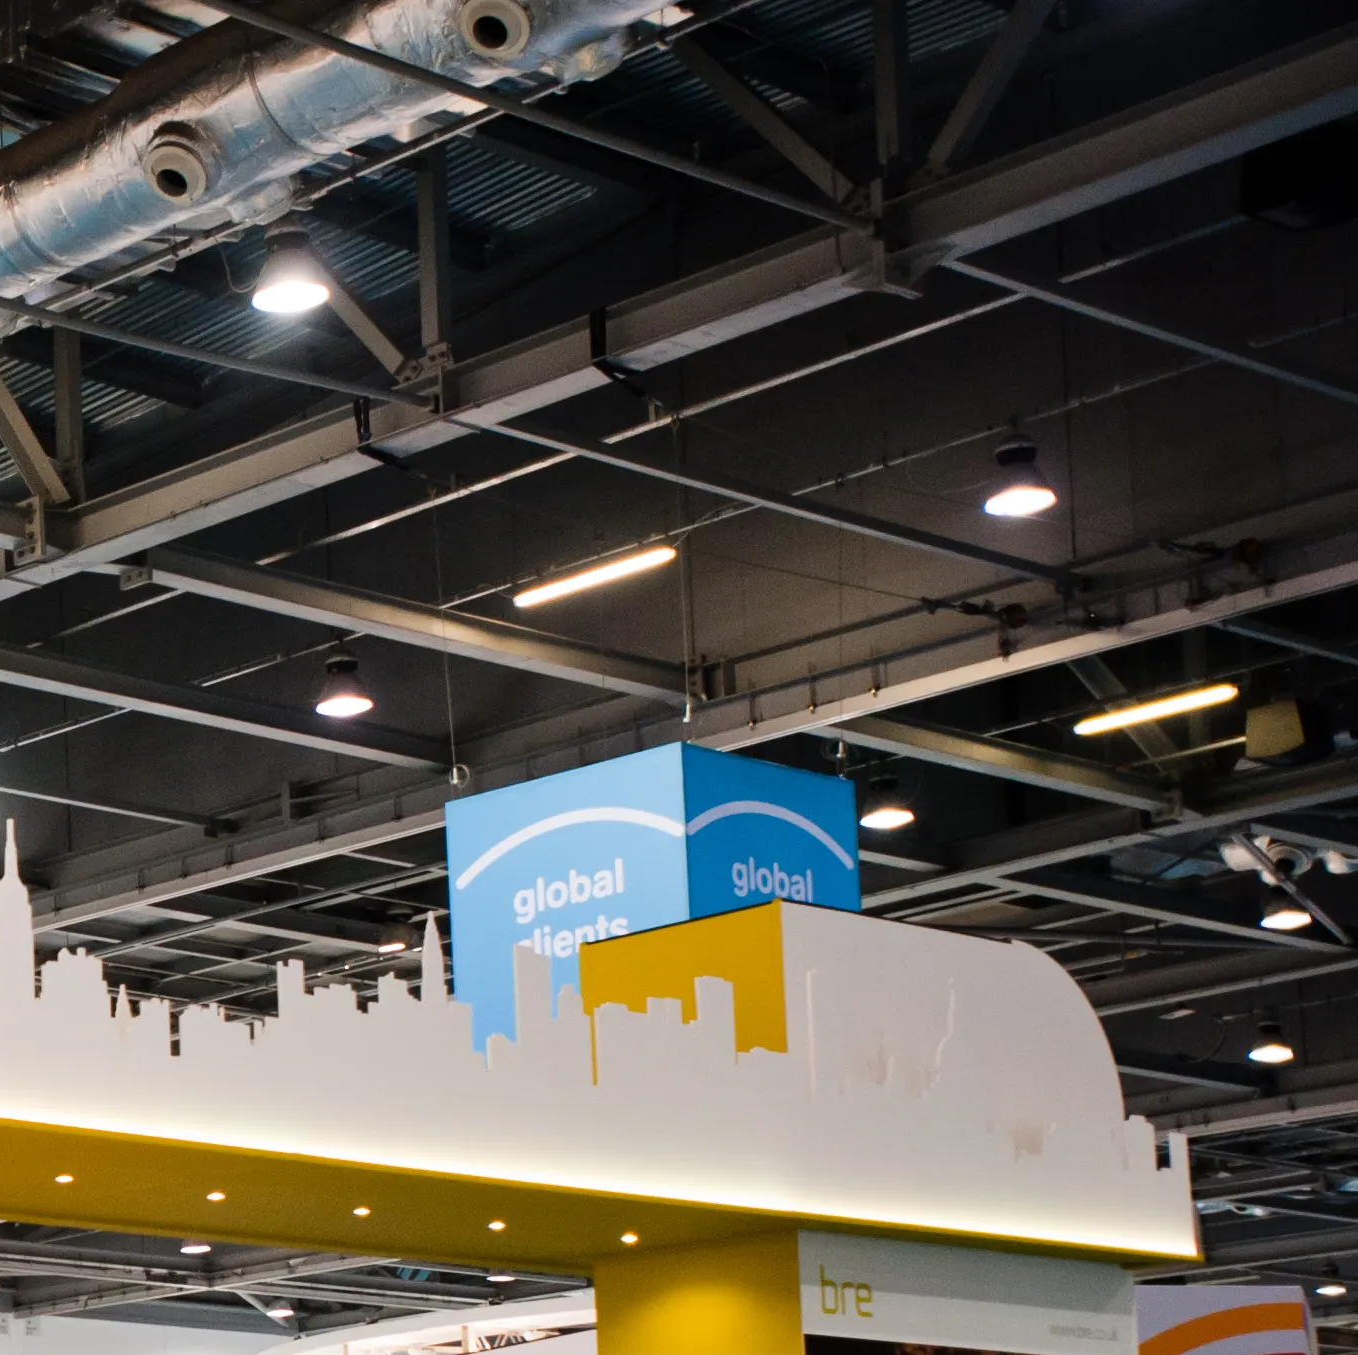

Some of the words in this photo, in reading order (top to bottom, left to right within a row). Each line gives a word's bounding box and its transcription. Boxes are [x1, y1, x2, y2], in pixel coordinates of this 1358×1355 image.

[513, 858, 625, 924] global
[731, 856, 813, 903] global
[820, 1263, 874, 1318] bre
